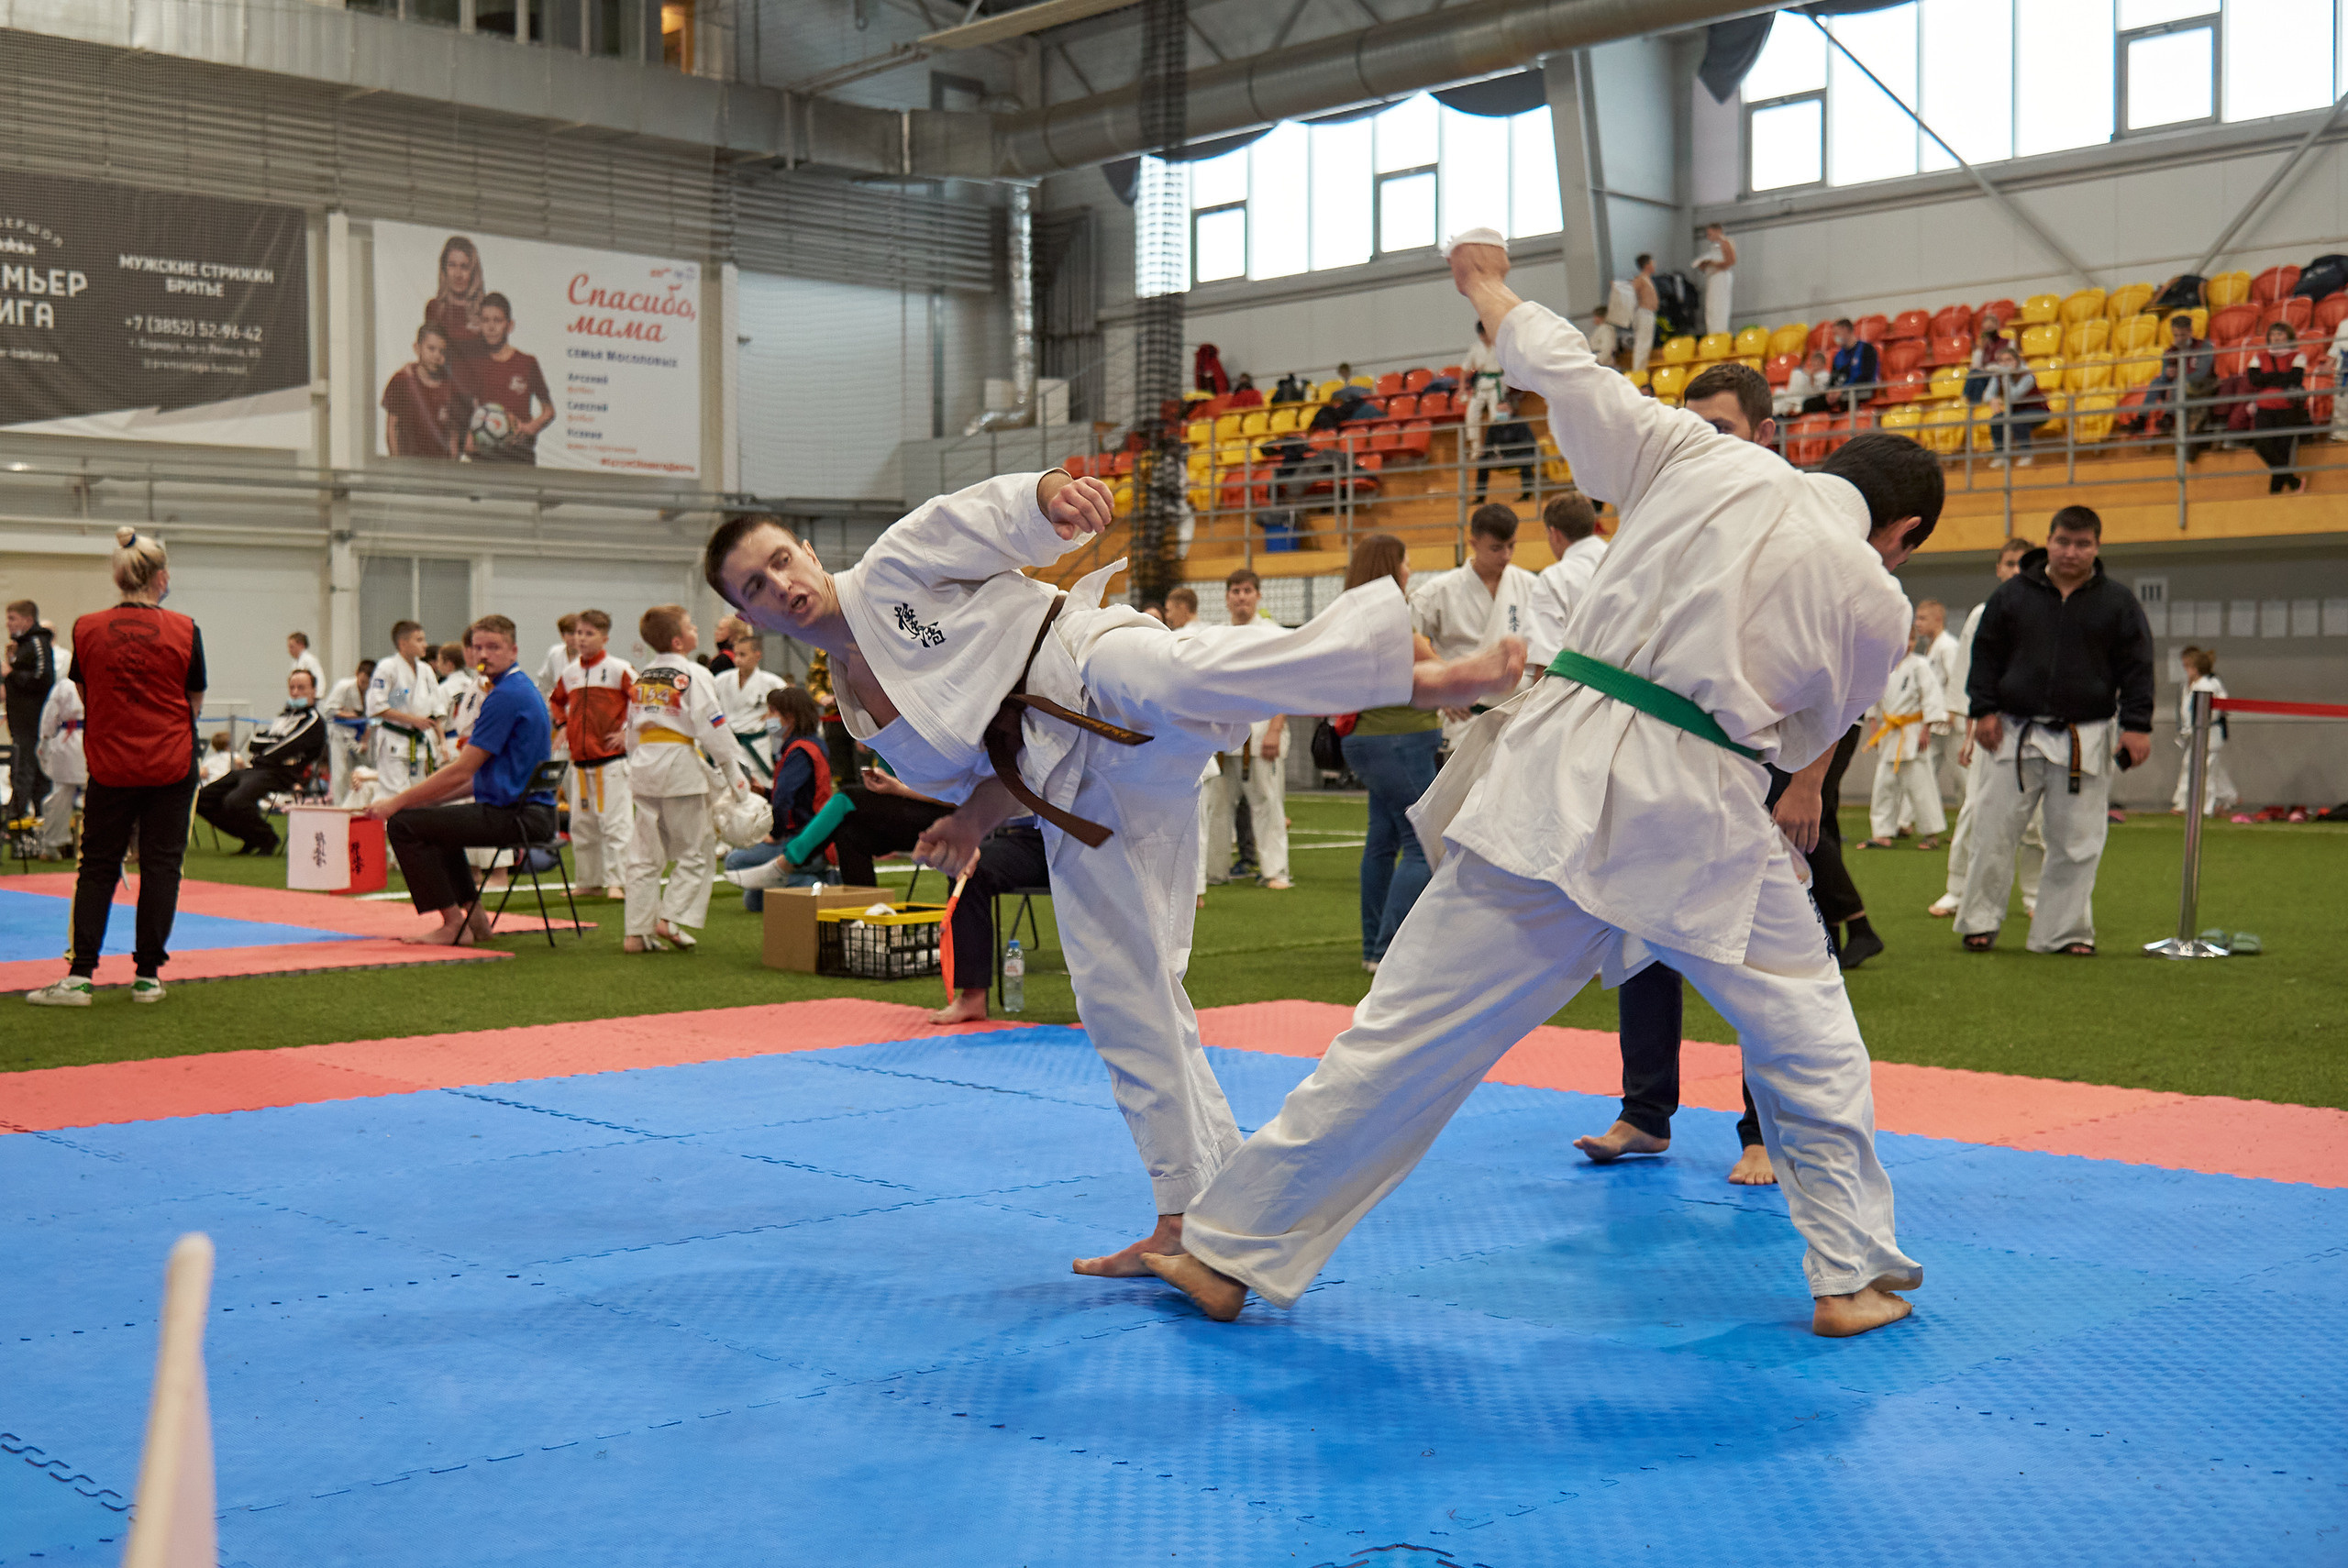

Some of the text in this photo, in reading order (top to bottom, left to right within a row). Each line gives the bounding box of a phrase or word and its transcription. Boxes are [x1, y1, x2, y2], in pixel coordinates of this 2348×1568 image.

[2, 263, 88, 298] МЬЕР
[119, 254, 274, 283] МУЖСКИЕ СТРИЖКИ
[165, 277, 225, 297] БРИТЬЕ
[568, 273, 696, 321] Спасибо,
[126, 315, 263, 342] +7 (3852) 52-96-42
[567, 316, 668, 342] мама
